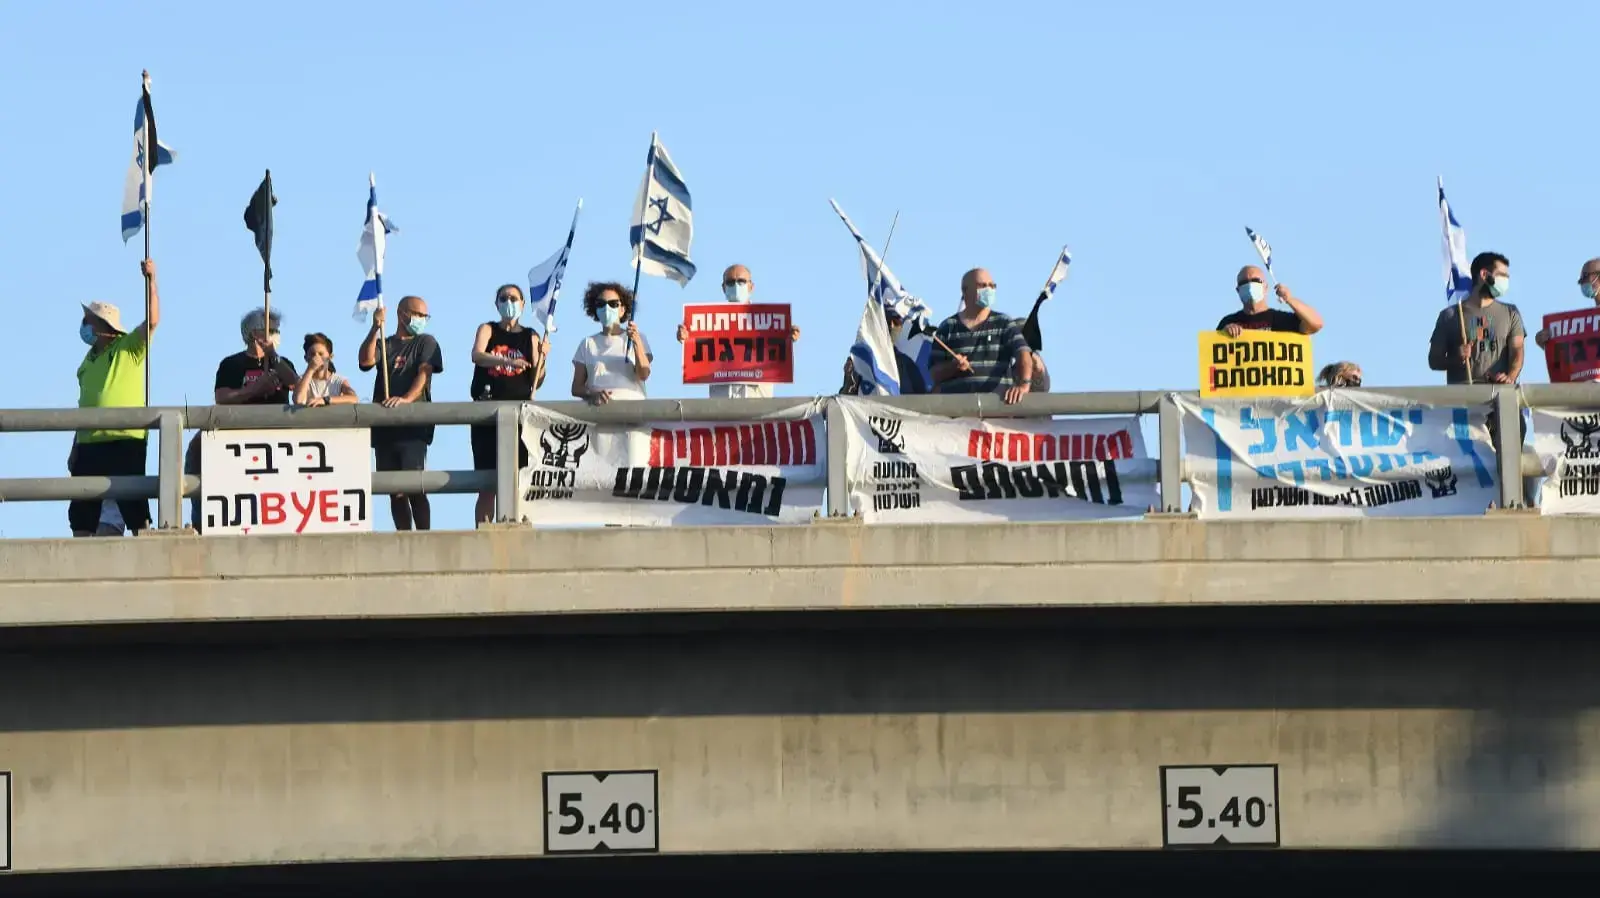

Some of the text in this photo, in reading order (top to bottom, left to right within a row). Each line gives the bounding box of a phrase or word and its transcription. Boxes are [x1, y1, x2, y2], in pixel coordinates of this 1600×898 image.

[690, 312, 786, 332] השחיתות
[692, 337, 786, 363] הורגת
[1212, 341, 1303, 366] מנותקים
[1209, 366, 1305, 392] נמאסתם!
[1240, 407, 1423, 455] ישראל
[873, 492, 920, 513] השלטון
[558, 792, 645, 835] 5.40
[1177, 786, 1266, 829] 5.40
